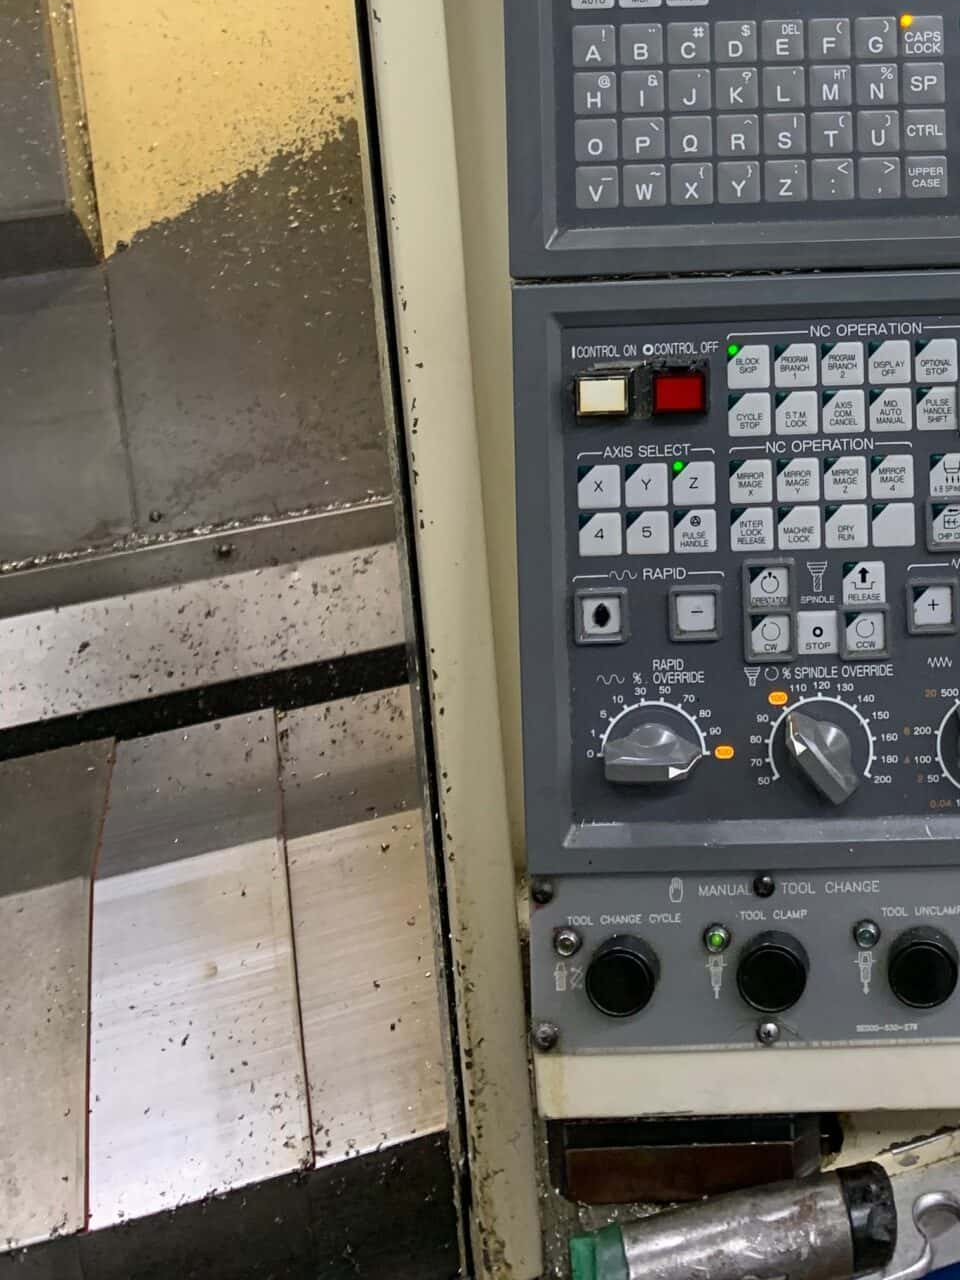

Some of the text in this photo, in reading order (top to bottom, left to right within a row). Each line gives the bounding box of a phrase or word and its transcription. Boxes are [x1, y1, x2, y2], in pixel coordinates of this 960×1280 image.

[904, 31, 942, 43] CAPS
[905, 43, 942, 54] LOCK
[910, 75, 938, 92] SP
[906, 124, 944, 137] CTRL
[907, 166, 944, 178] UPPER
[911, 178, 941, 188] CASE
[810, 322, 922, 337] NC OPERATION
[576, 344, 637, 359] CONTROL ON
[653, 340, 720, 356] CONTROL OFF
[603, 443, 691, 458] AXIS SELECT
[765, 438, 874, 454] NC OPERATION
[642, 567, 687, 580] RAPID
[805, 641, 831, 650] STOP
[652, 658, 685, 671] RAPID
[653, 671, 705, 684] OVERRIDE
[794, 664, 894, 680] SPINDLE OVERRIDE
[698, 880, 880, 897] MANUAL TOOL CHANGE
[739, 909, 808, 921] TOOL CLAMP
[881, 907, 908, 917] TOOL
[567, 913, 681, 926] TOOL CHANGE CYCLE
